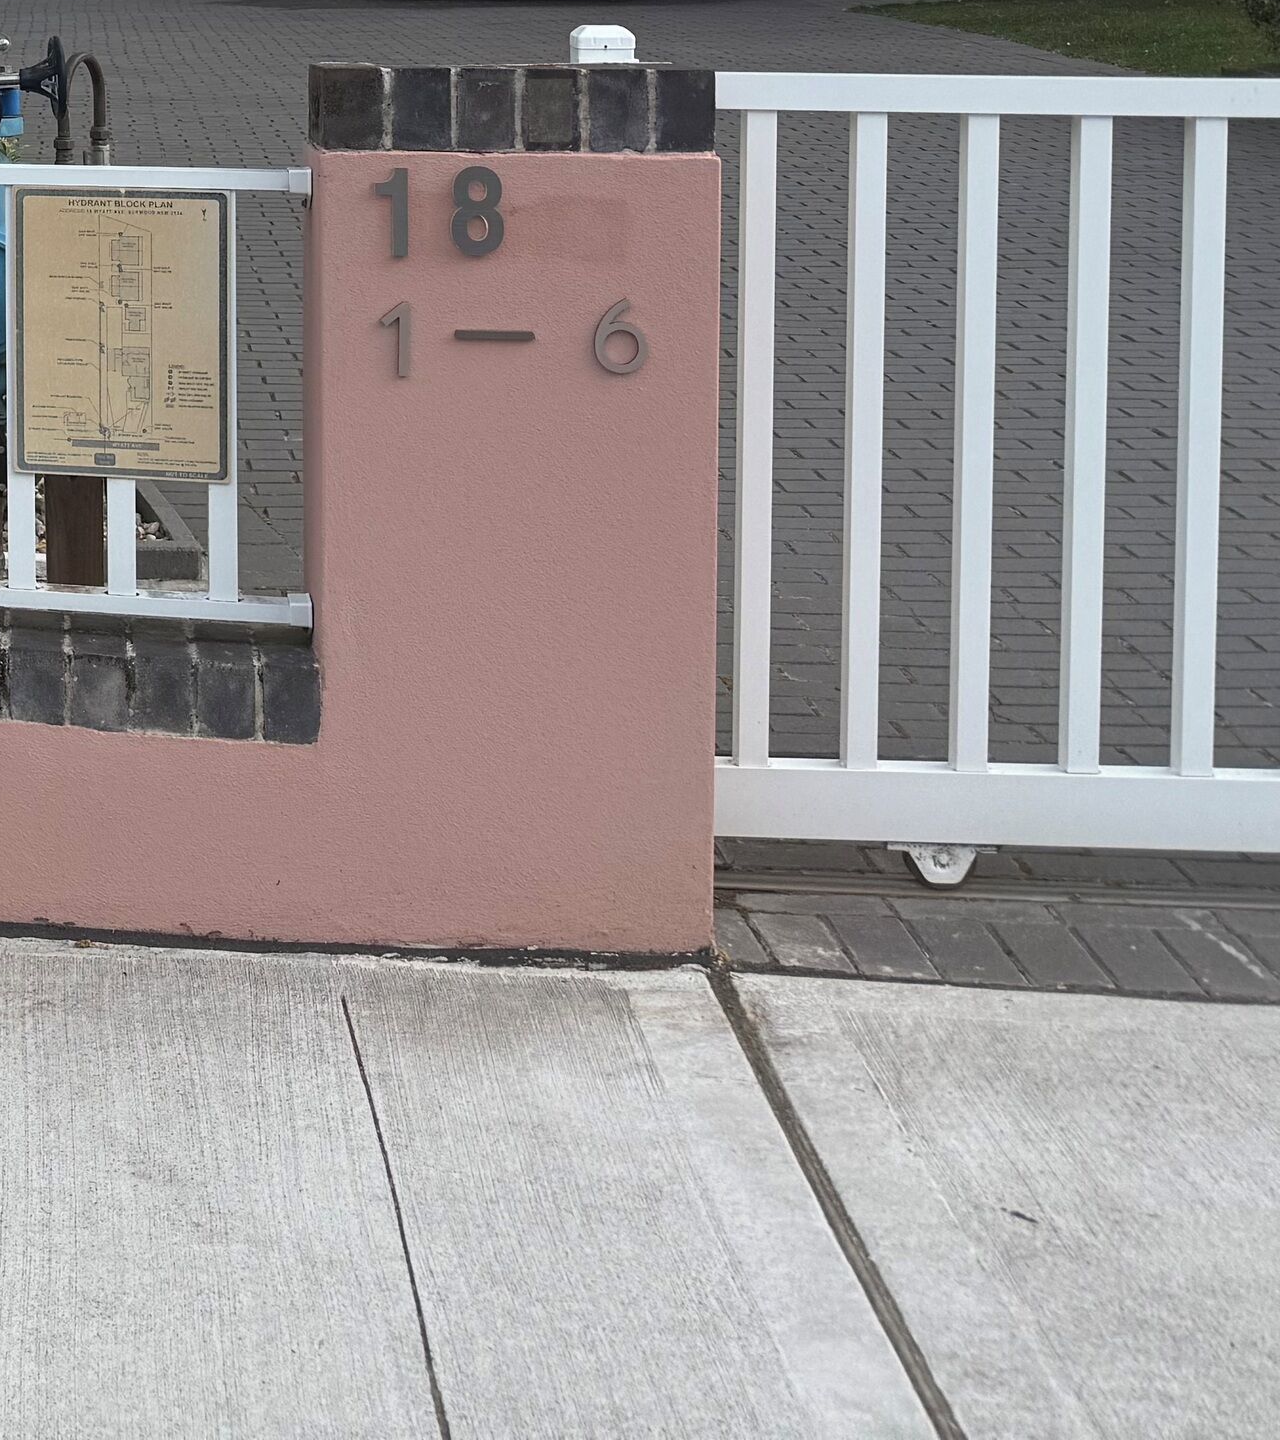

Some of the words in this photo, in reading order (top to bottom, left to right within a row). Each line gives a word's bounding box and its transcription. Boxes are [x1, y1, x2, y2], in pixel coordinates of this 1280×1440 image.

[68, 199, 113, 208] HYDRANT
[114, 200, 146, 208] BLOCK
[148, 201, 173, 209] PLAN
[372, 165, 505, 258] 18
